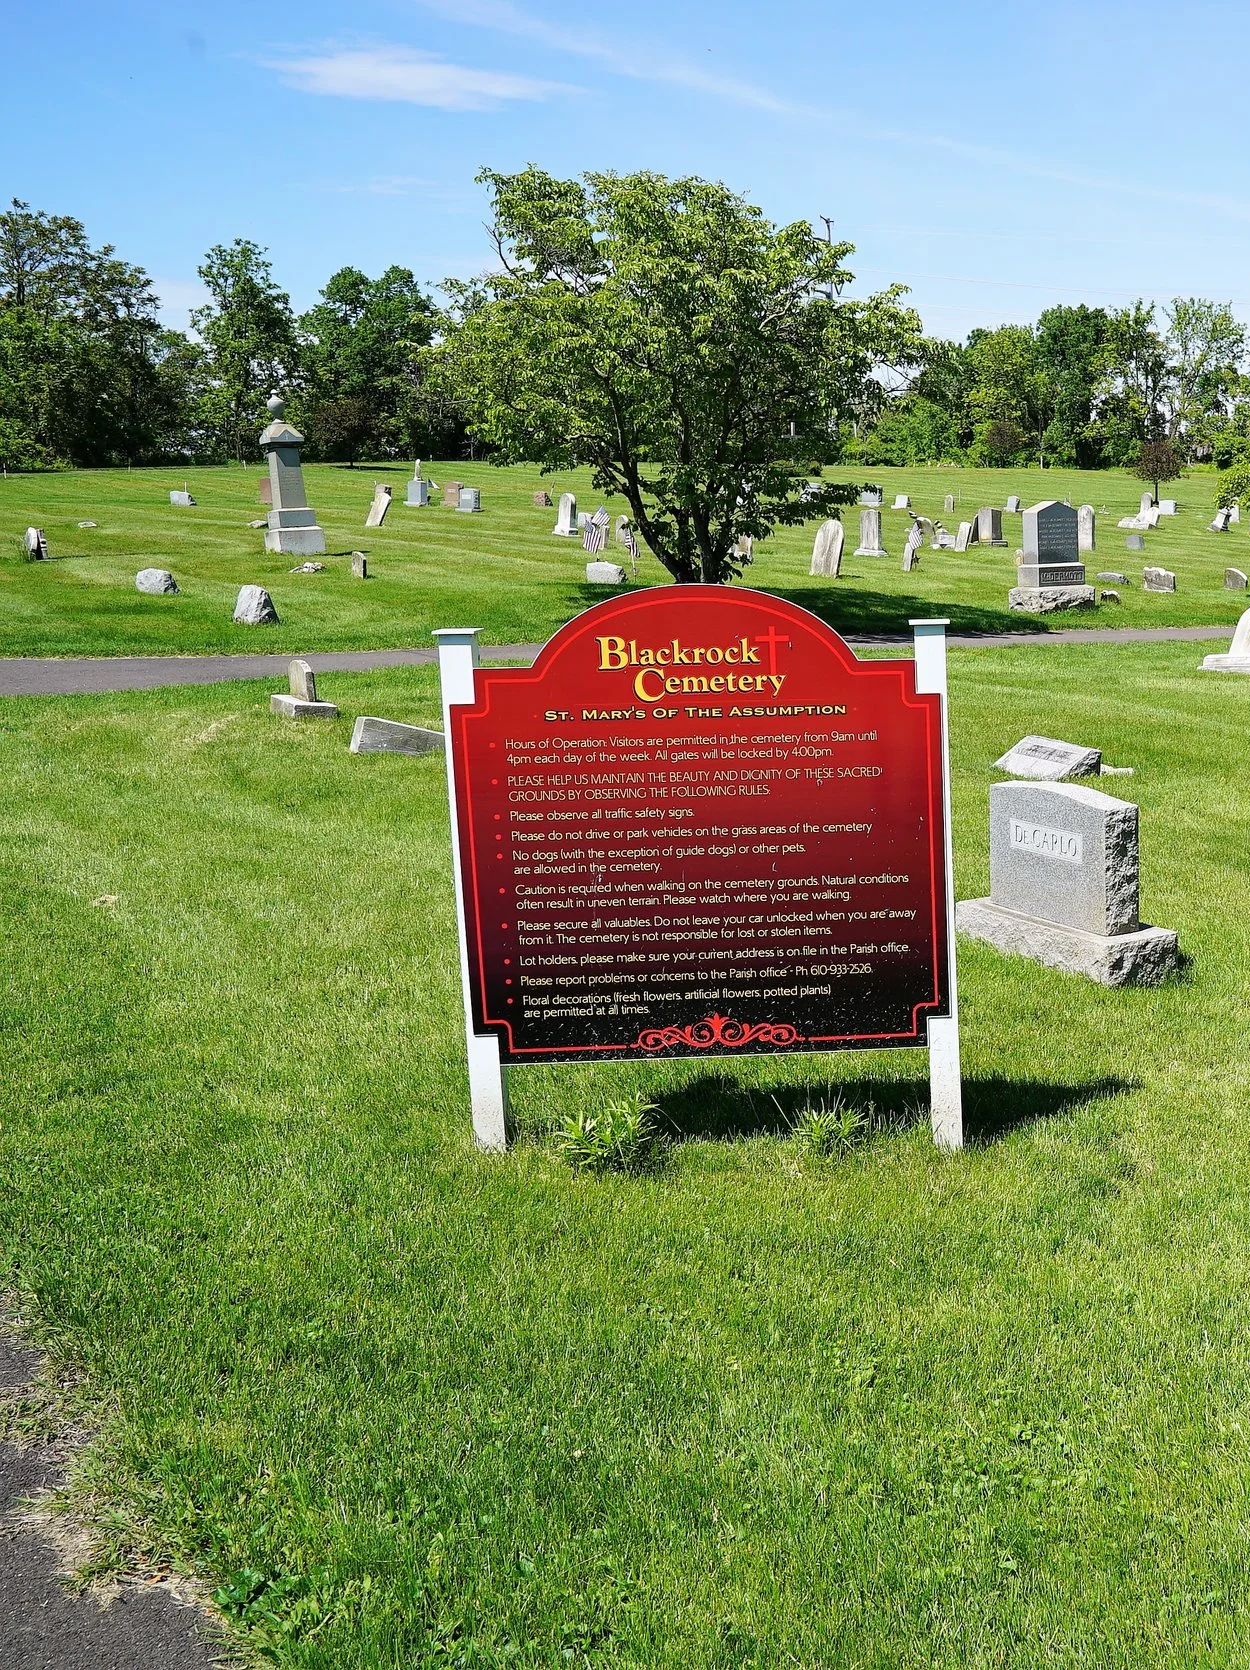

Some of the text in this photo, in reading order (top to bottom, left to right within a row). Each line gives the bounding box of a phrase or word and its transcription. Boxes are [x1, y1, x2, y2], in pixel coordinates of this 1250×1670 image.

[595, 636, 761, 672] Blackrock
[634, 667, 787, 703] Cemetery
[544, 704, 846, 721] ST. MARY'S OF THE ASSUMPTION
[506, 738, 535, 749] Hours
[539, 738, 549, 748] of
[609, 736, 644, 746] Visitors
[647, 738, 663, 746] are
[667, 734, 716, 748] permitted
[730, 733, 747, 744] the
[751, 732, 801, 746] cemetery
[804, 731, 828, 742] from
[831, 731, 854, 741] 9am
[858, 730, 877, 740] until
[507, 753, 531, 767] 4pm
[534, 753, 560, 763] each
[564, 752, 582, 766] day
[586, 752, 596, 762] of
[600, 751, 616, 762] the
[655, 750, 667, 760] All
[671, 749, 699, 763] gates
[702, 748, 718, 759] will
[721, 748, 734, 758] be
[738, 747, 772, 758] locked
[776, 747, 789, 760] by
[508, 767, 834, 786] PLEASE HELP US MAINTAIN THE BEAUTY AND DIGNITY OF THESE
[509, 790, 565, 802] GROUNDS
[569, 790, 581, 800] BY
[585, 788, 646, 800] OBSERVING
[649, 788, 668, 798] THE
[671, 786, 736, 797] FOLLOWING
[510, 810, 543, 821] Please
[547, 809, 588, 820] observe
[592, 809, 602, 819] all
[605, 808, 632, 819] traffic
[635, 807, 665, 821] safety
[512, 820, 872, 841] Please do not drive park vehicles the grass areas of the cemetery
[513, 850, 529, 860] No
[532, 849, 558, 863] dogs
[588, 847, 604, 858] the
[608, 846, 659, 860] exception
[663, 845, 673, 856] of
[676, 844, 704, 858] guide
[753, 842, 779, 853] other
[514, 866, 530, 874] are
[534, 863, 575, 874] allowed
[590, 862, 606, 872] the
[516, 884, 555, 895] Caution
[569, 882, 611, 896] required
[615, 881, 644, 892] when
[647, 879, 685, 894] walking
[705, 878, 721, 889] the
[725, 877, 774, 891] cemetery
[822, 874, 856, 885] Natural
[859, 872, 909, 883] conditions
[516, 899, 543, 909] often
[547, 898, 573, 908] result
[588, 898, 625, 907] uneven
[664, 894, 696, 905] Please
[699, 893, 730, 903] watch
[734, 891, 767, 902] where
[770, 893, 789, 904] you
[793, 893, 808, 901] are
[518, 920, 551, 931] Please
[554, 921, 588, 930] secure
[592, 918, 601, 928] all
[654, 916, 670, 926] Do
[673, 915, 689, 926] not
[693, 914, 720, 925] leave
[723, 916, 745, 927] your
[749, 915, 763, 923] car
[767, 911, 813, 922] unlocked
[816, 910, 845, 921] when
[848, 911, 867, 923] you
[889, 910, 916, 921] away
[519, 934, 543, 945] from
[557, 933, 576, 943] The
[579, 931, 629, 946] cemetery
[642, 930, 658, 941] not
[662, 928, 718, 943] responsible
[721, 928, 735, 938] for
[738, 927, 754, 937] lost
[771, 925, 801, 936] stolen
[520, 955, 535, 966] Lot
[581, 952, 613, 966] please
[617, 951, 645, 962] make
[649, 953, 669, 961] sure
[673, 952, 695, 963] your
[699, 948, 733, 959] current
[736, 946, 774, 958] address
[803, 945, 816, 955] file
[831, 944, 847, 954] the
[851, 943, 877, 954] Parish
[521, 975, 552, 986] Please
[556, 974, 586, 988] report
[589, 972, 635, 987] problems
[651, 972, 694, 981] concerns
[711, 968, 726, 979] the
[730, 967, 756, 978] Parish
[760, 966, 787, 977] office
[796, 965, 808, 975] Ph
[523, 995, 549, 1006] Floral
[552, 993, 611, 1005] decorations
[685, 988, 720, 999] artificial
[764, 985, 797, 999] potted
[524, 1005, 593, 1020] are permitted
